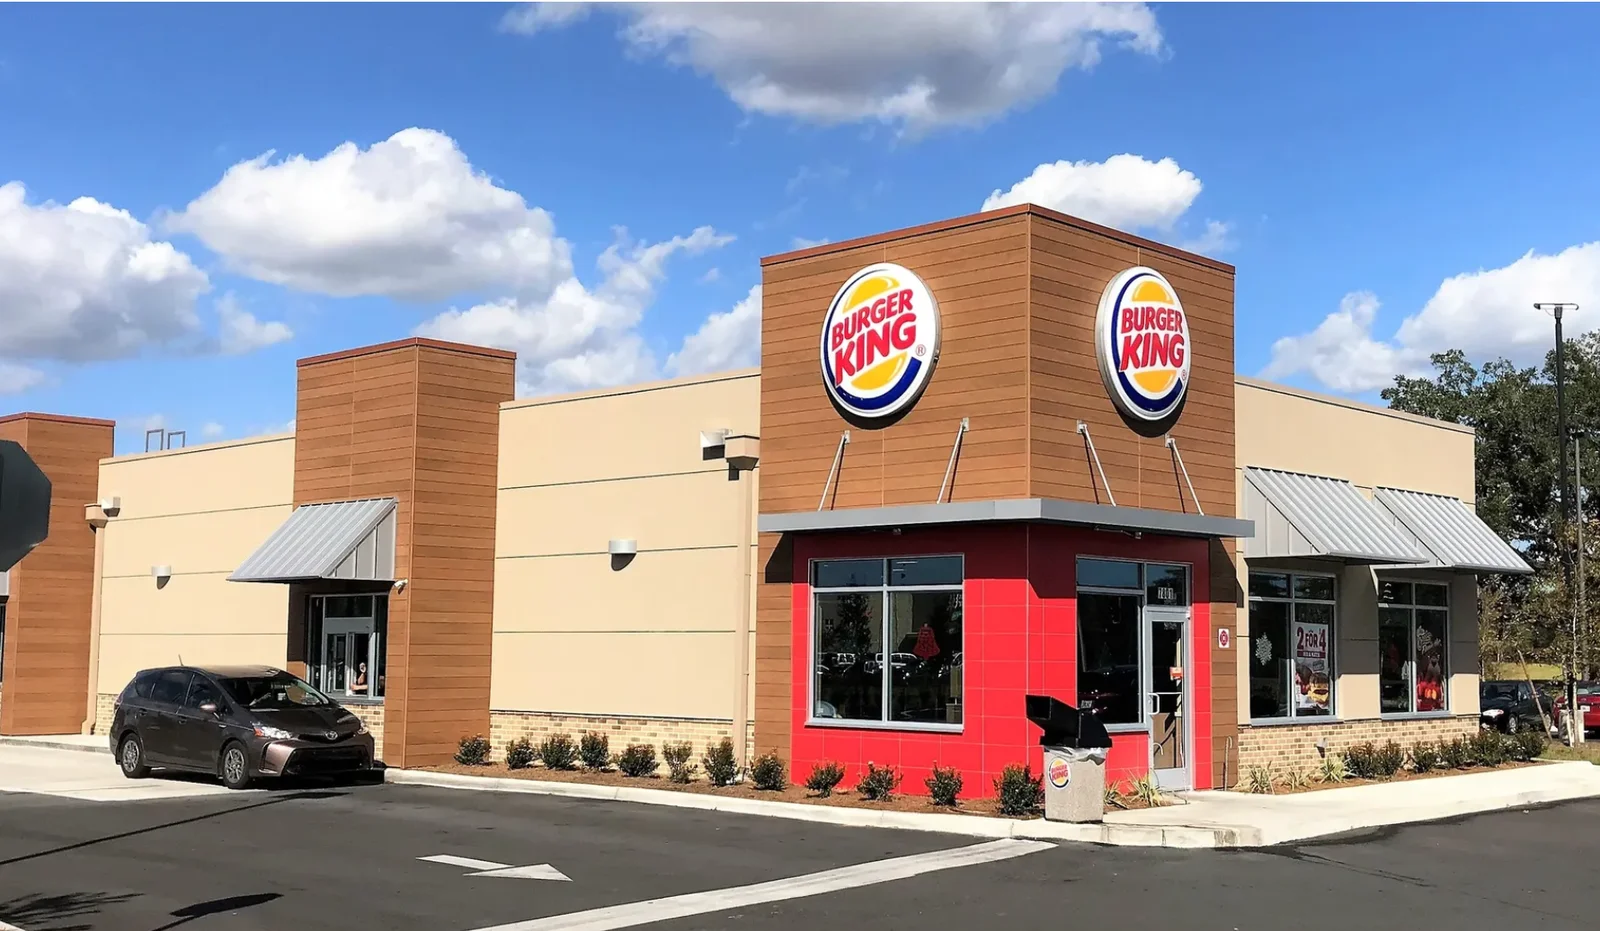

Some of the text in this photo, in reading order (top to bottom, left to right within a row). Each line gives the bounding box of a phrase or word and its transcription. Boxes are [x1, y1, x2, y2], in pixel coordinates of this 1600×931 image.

[832, 288, 913, 352] BURGER
[1121, 306, 1183, 334] BURGER
[835, 313, 916, 386] KING
[1120, 332, 1184, 371] KING
[1296, 626, 1304, 650] 2
[1305, 633, 1318, 648] FOR
[1051, 769, 1069, 781] KING
